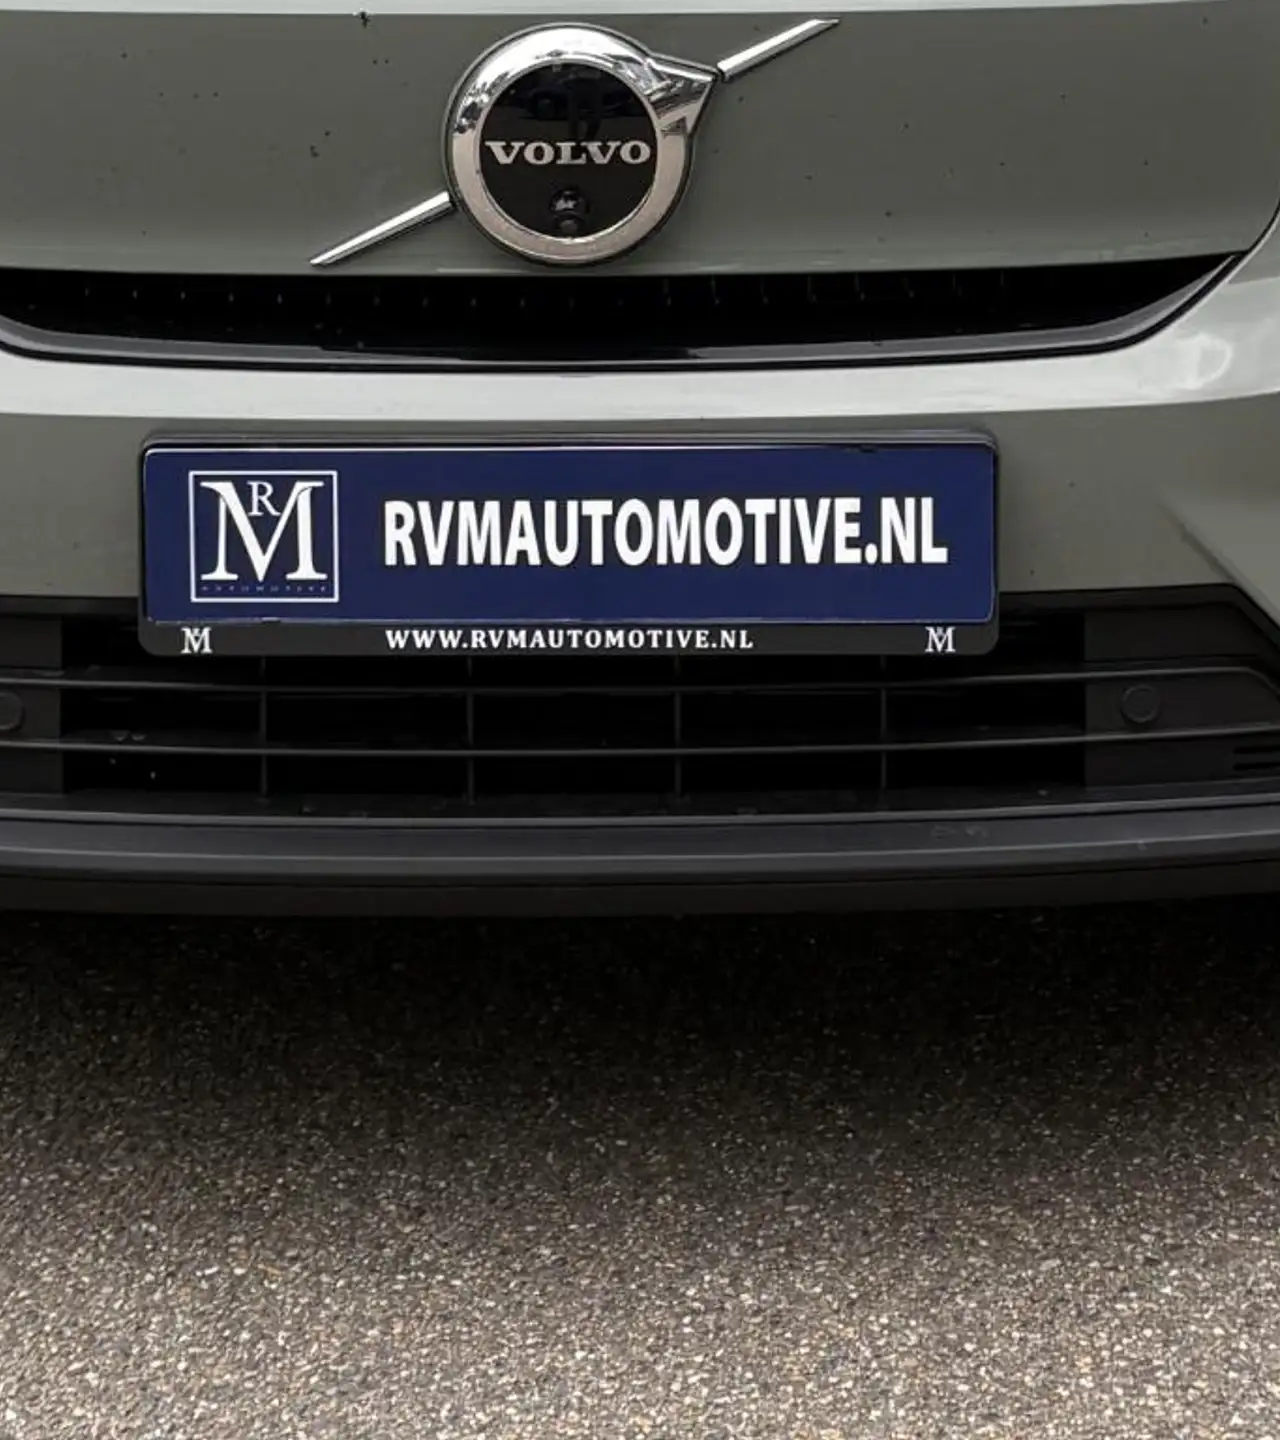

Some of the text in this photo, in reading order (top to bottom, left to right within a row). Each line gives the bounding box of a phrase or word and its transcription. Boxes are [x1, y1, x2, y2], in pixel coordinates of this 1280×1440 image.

[484, 140, 651, 165] VOLVO
[384, 497, 948, 566] RVMAUTOMOTIVE.NL
[385, 629, 754, 649] WWW.RVMAUTOMOTIVE.NL
